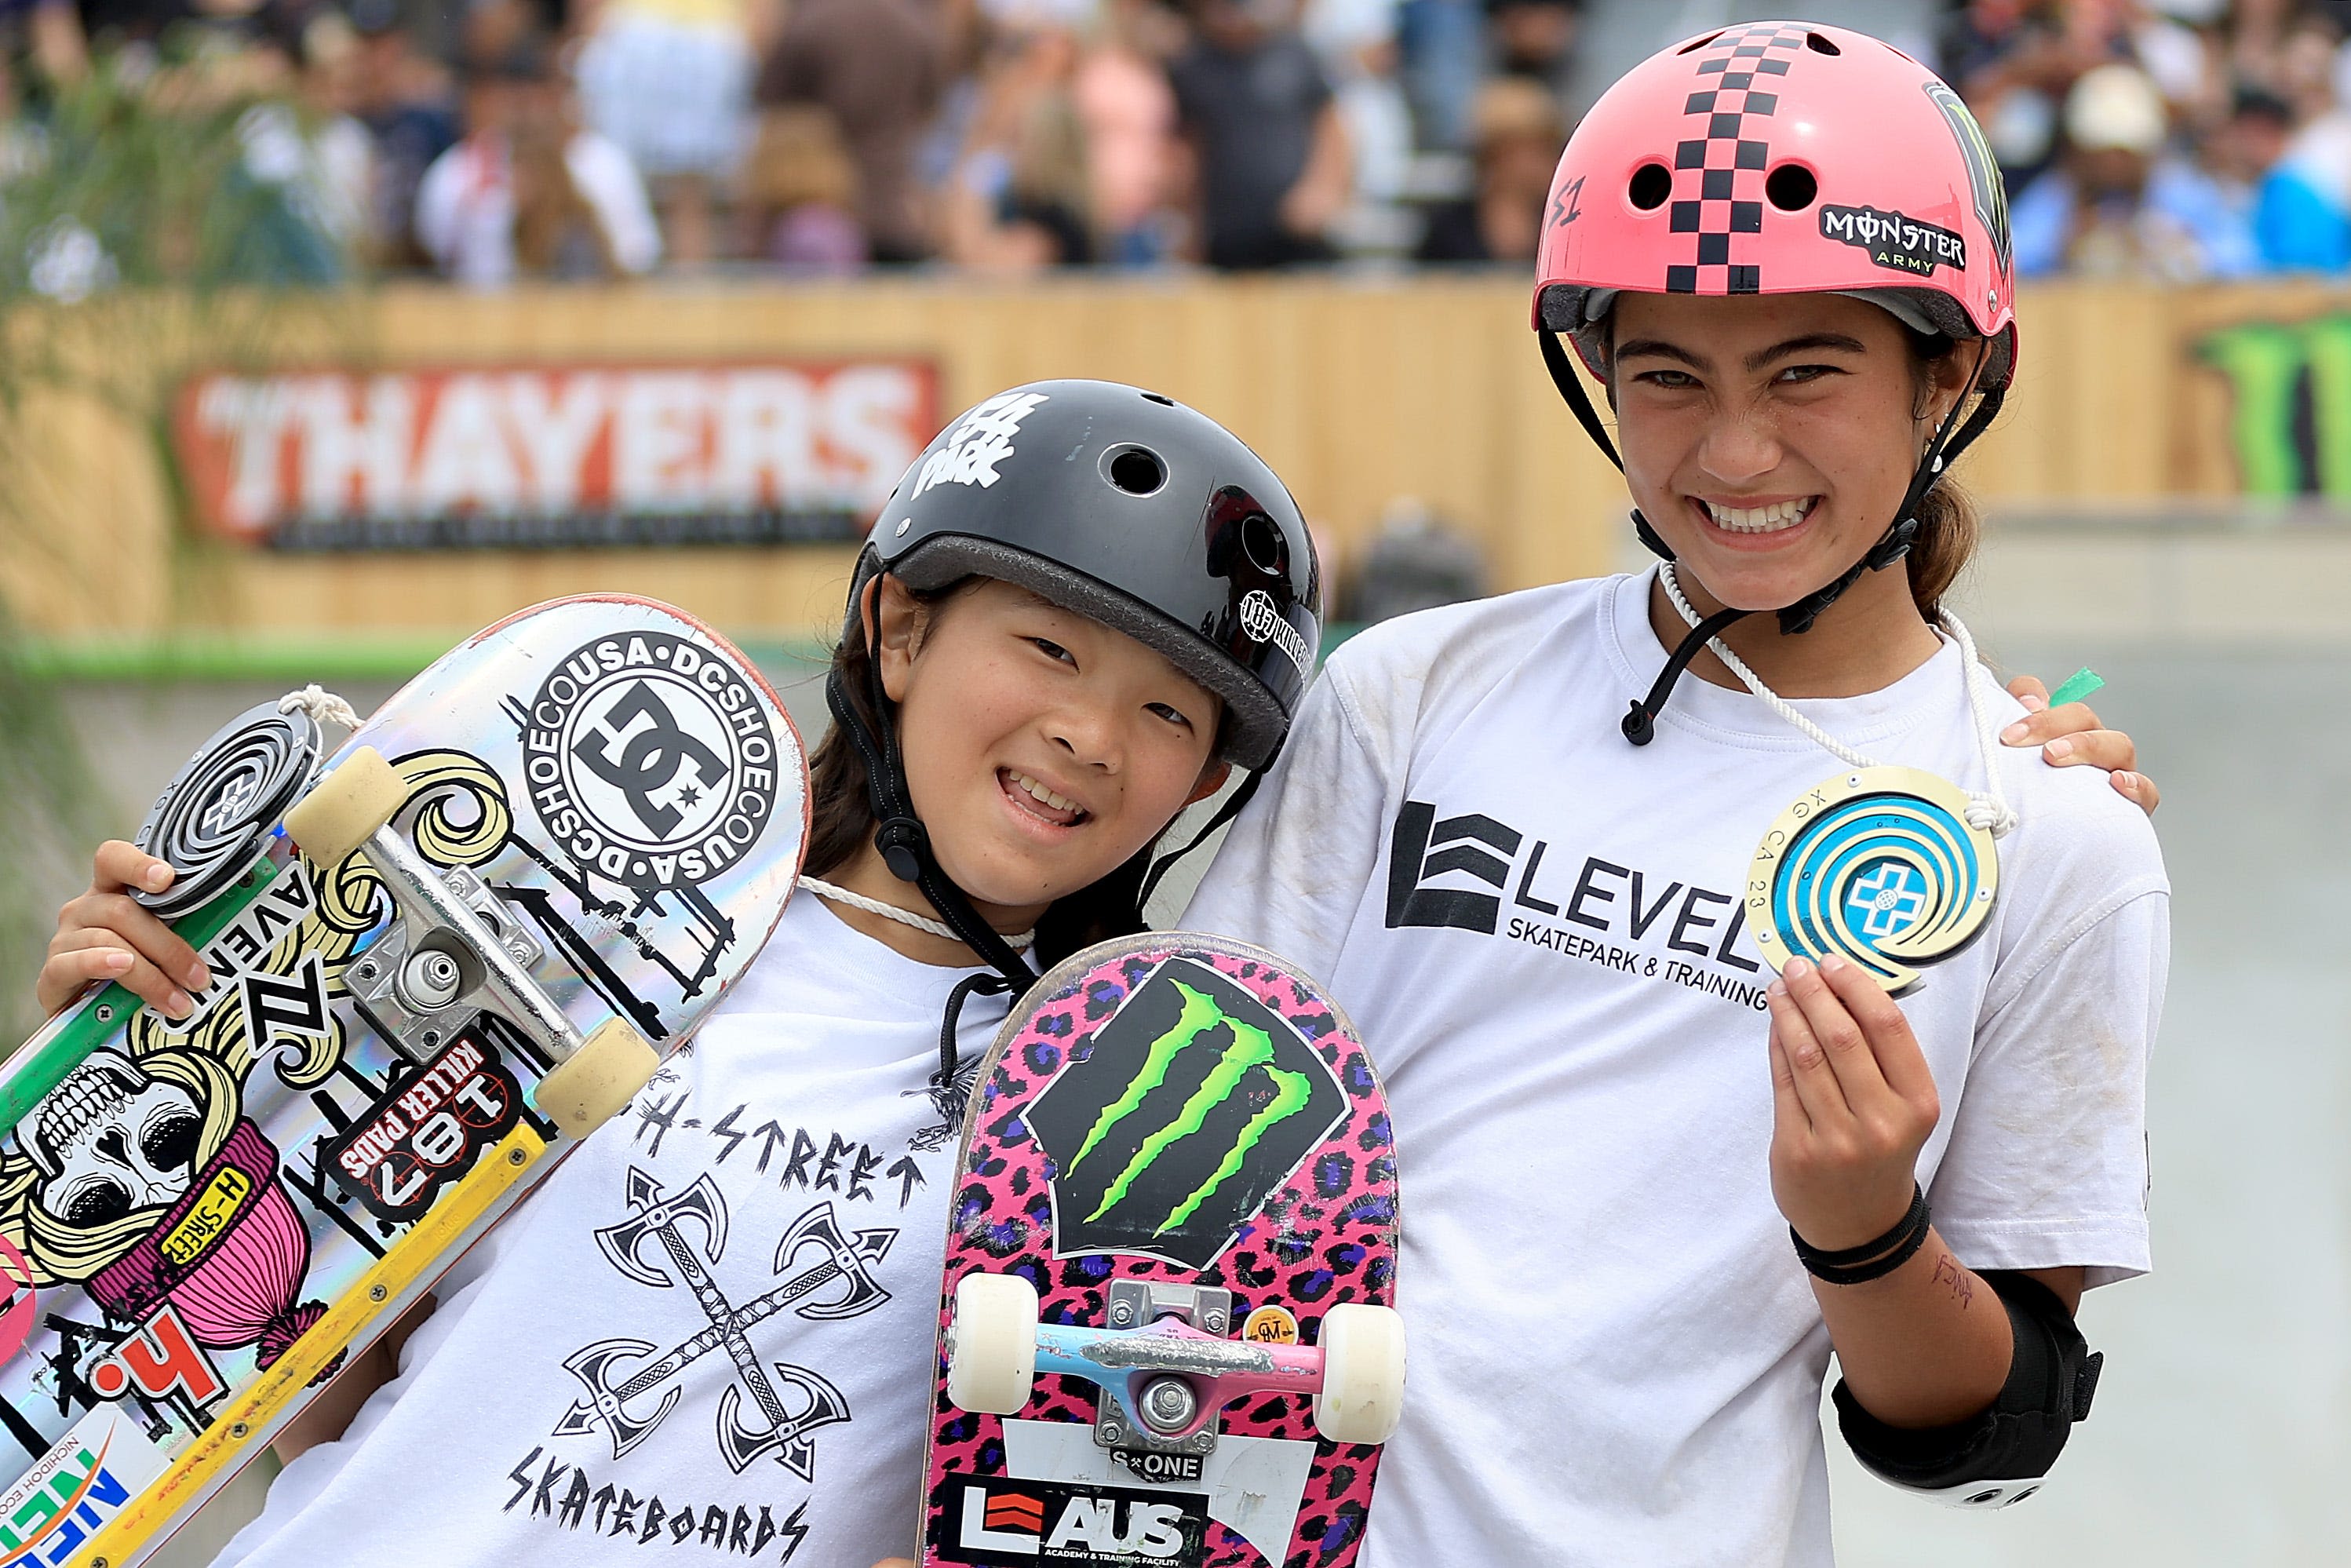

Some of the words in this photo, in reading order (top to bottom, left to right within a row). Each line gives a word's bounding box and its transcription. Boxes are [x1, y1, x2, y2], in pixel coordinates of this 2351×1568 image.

[1876, 252, 1934, 272] ARMY
[198, 367, 917, 527] THAYERS
[1793, 789, 1827, 819] XG
[1756, 830, 1785, 861] CA
[1514, 840, 1763, 973] LEVEL
[1749, 881, 1766, 909] 23
[1506, 917, 1641, 975] SKATEPARK
[1643, 957, 1658, 977] &
[1664, 960, 1770, 1012] TRAINING
[397, 1038, 485, 1121] KILLER
[339, 1110, 410, 1179] PADS
[629, 1086, 928, 1211] H-STREET
[166, 1172, 245, 1262] H-STREET
[22, 1436, 80, 1493] NICHIDOH
[501, 1442, 812, 1568] SKATEBOARDS
[1044, 1548, 1089, 1560] ACADEMY
[1142, 1557, 1180, 1567] FACILITY
